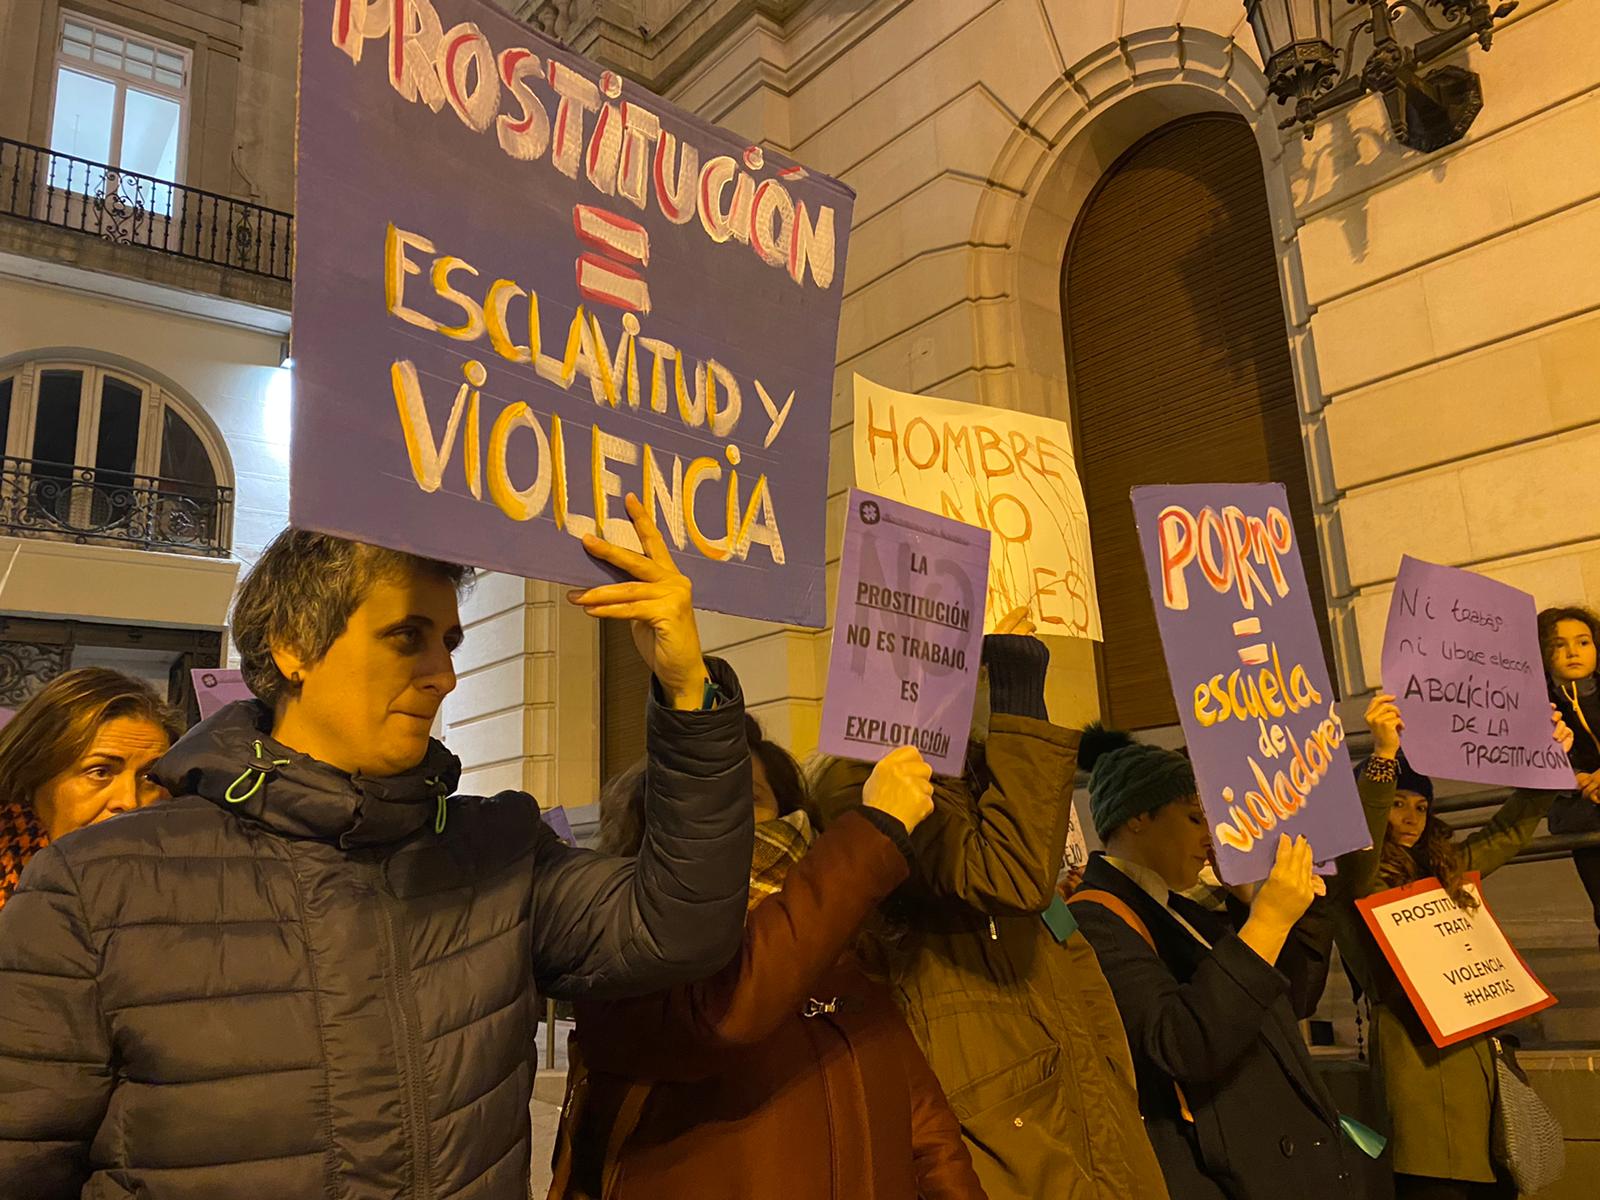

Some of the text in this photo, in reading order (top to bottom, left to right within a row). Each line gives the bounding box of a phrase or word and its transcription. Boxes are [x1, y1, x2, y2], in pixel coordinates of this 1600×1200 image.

[867, 396, 1062, 480] HOMBRE
[940, 489, 1032, 542] NO
[910, 552, 928, 575] LA
[856, 582, 970, 632] PROSTITUCIÓN
[1400, 588, 1435, 620] Ni
[846, 624, 871, 648] NO
[877, 631, 896, 653] ES
[1400, 637, 1427, 656] ni
[900, 680, 919, 703] ES
[1193, 641, 1322, 728] escuela
[845, 715, 951, 755] EXPLOTACIÓN
[1258, 717, 1287, 760] de
[1451, 714, 1509, 737] DE LA
[1460, 741, 1569, 769] PROSTITUCIÓN
[1215, 700, 1345, 853] violadores
[1433, 917, 1474, 937] TRATA
[1442, 956, 1506, 985] VIOLENCIA
[1463, 979, 1516, 1006] #HARTAS
